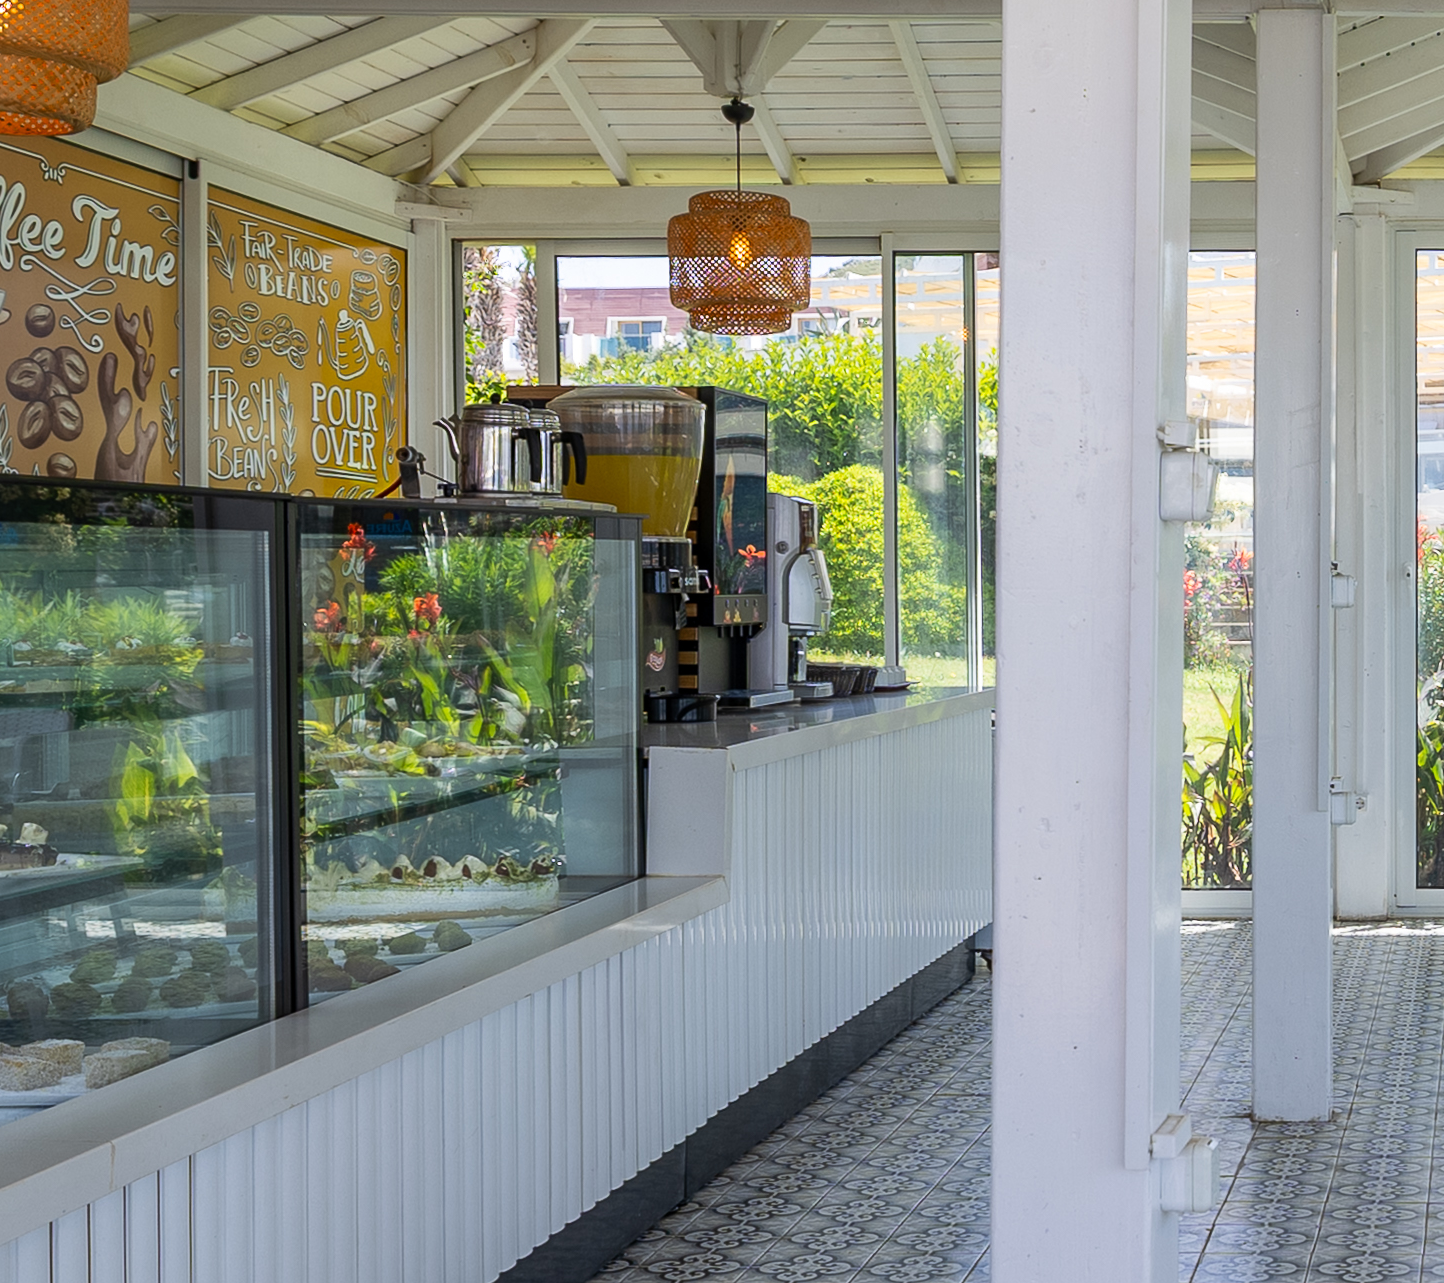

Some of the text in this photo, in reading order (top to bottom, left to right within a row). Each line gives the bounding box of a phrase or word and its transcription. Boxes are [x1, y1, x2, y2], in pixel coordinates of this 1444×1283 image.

[72, 195, 177, 287] Time
[257, 265, 329, 306] BEANS
[311, 383, 378, 432] POUR
[311, 424, 377, 471] OVER
